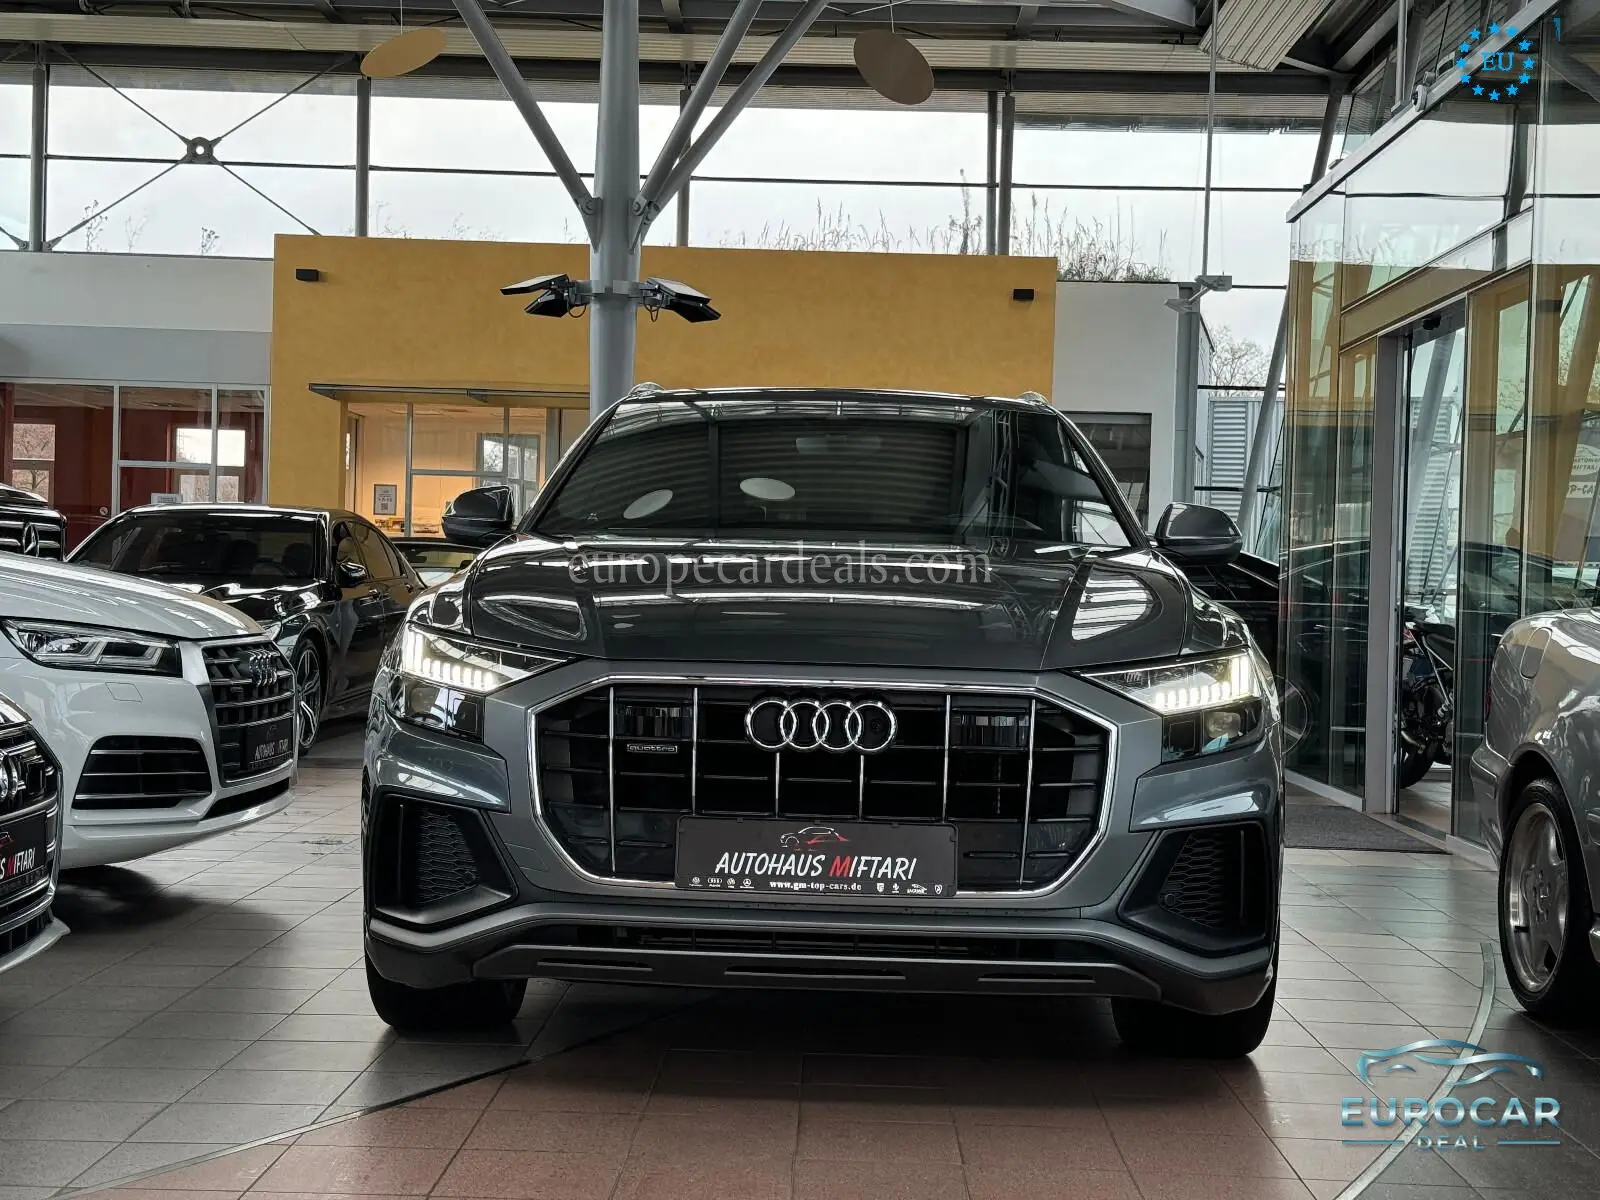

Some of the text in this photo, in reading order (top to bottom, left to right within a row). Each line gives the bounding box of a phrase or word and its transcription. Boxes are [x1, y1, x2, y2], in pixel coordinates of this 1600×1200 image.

[8, 847, 36, 875] MIFTARI
[715, 851, 917, 881] AUTOHAUS MIFTARI
[769, 880, 862, 892] www.gm-top-cars.de
